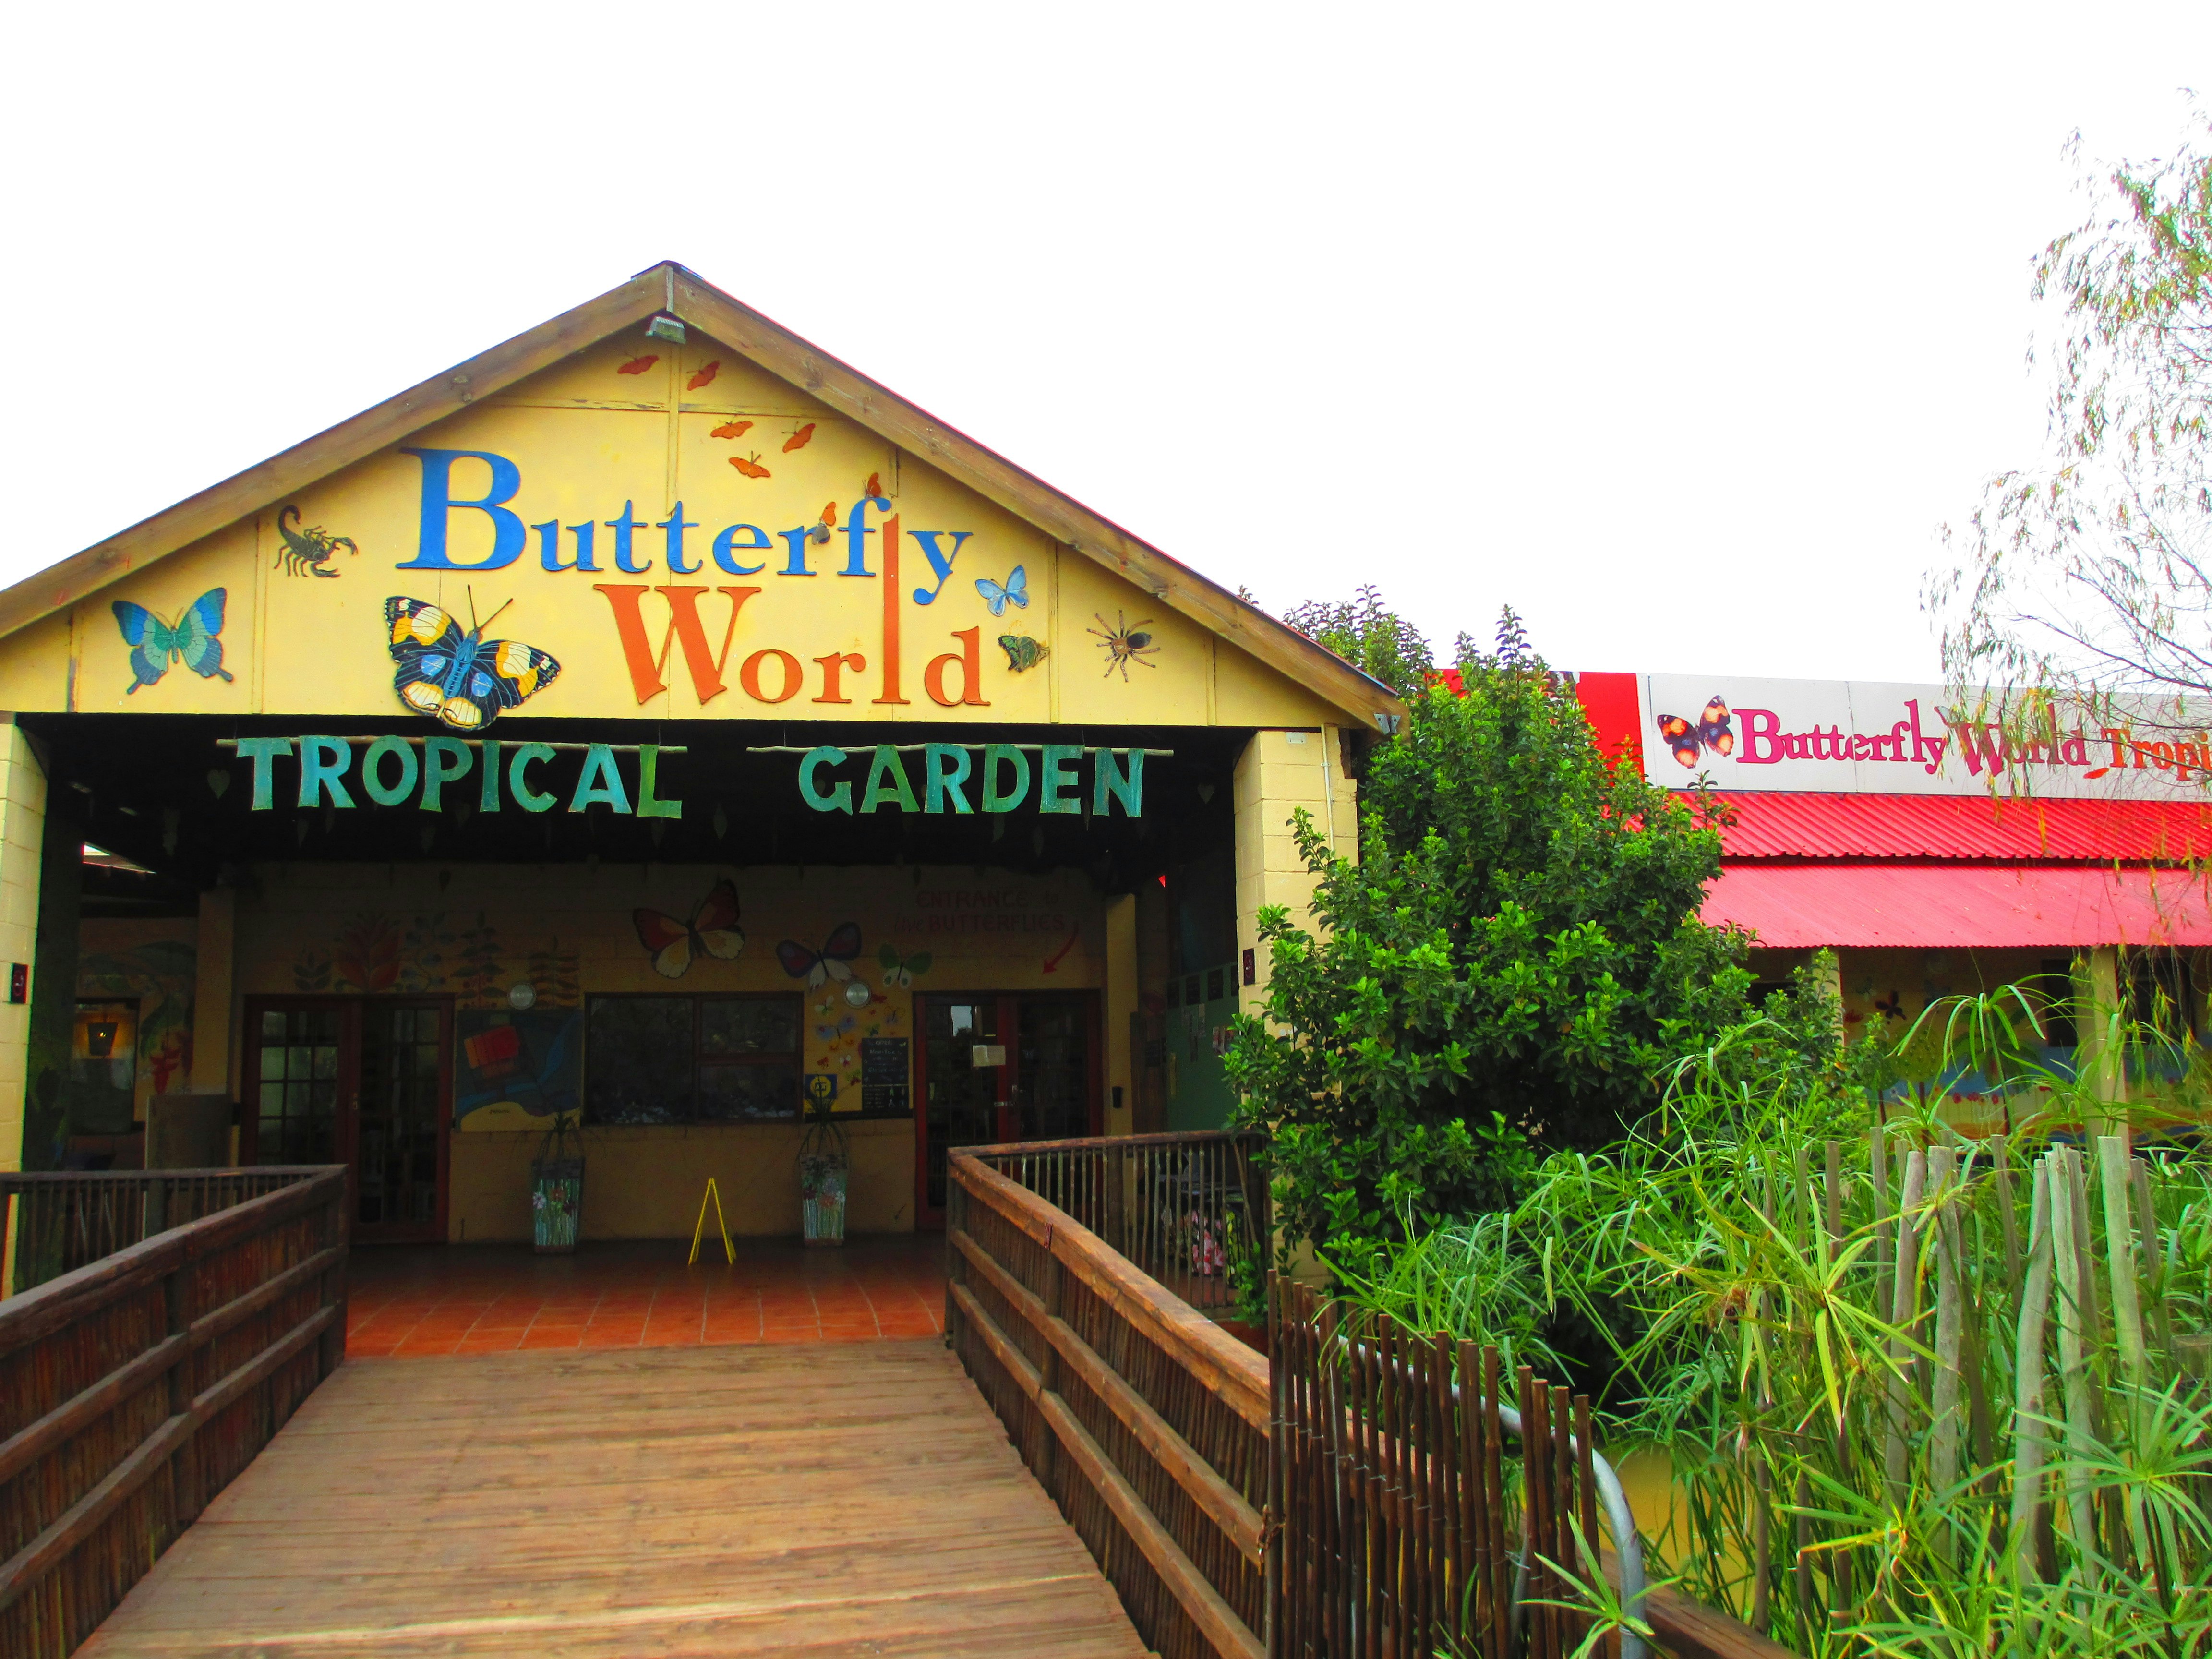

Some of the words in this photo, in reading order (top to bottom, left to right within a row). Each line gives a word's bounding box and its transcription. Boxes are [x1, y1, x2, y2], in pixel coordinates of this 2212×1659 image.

[395, 447, 974, 605] Butterfly
[593, 513, 991, 705] World
[235, 734, 682, 818] TROPICAL
[798, 742, 1144, 818] GARDEN
[1732, 699, 1948, 775] Butterfly
[916, 890, 1029, 909] ENTRANCE
[1044, 891, 1059, 905] to
[929, 913, 1065, 933] BUTTERFLIES
